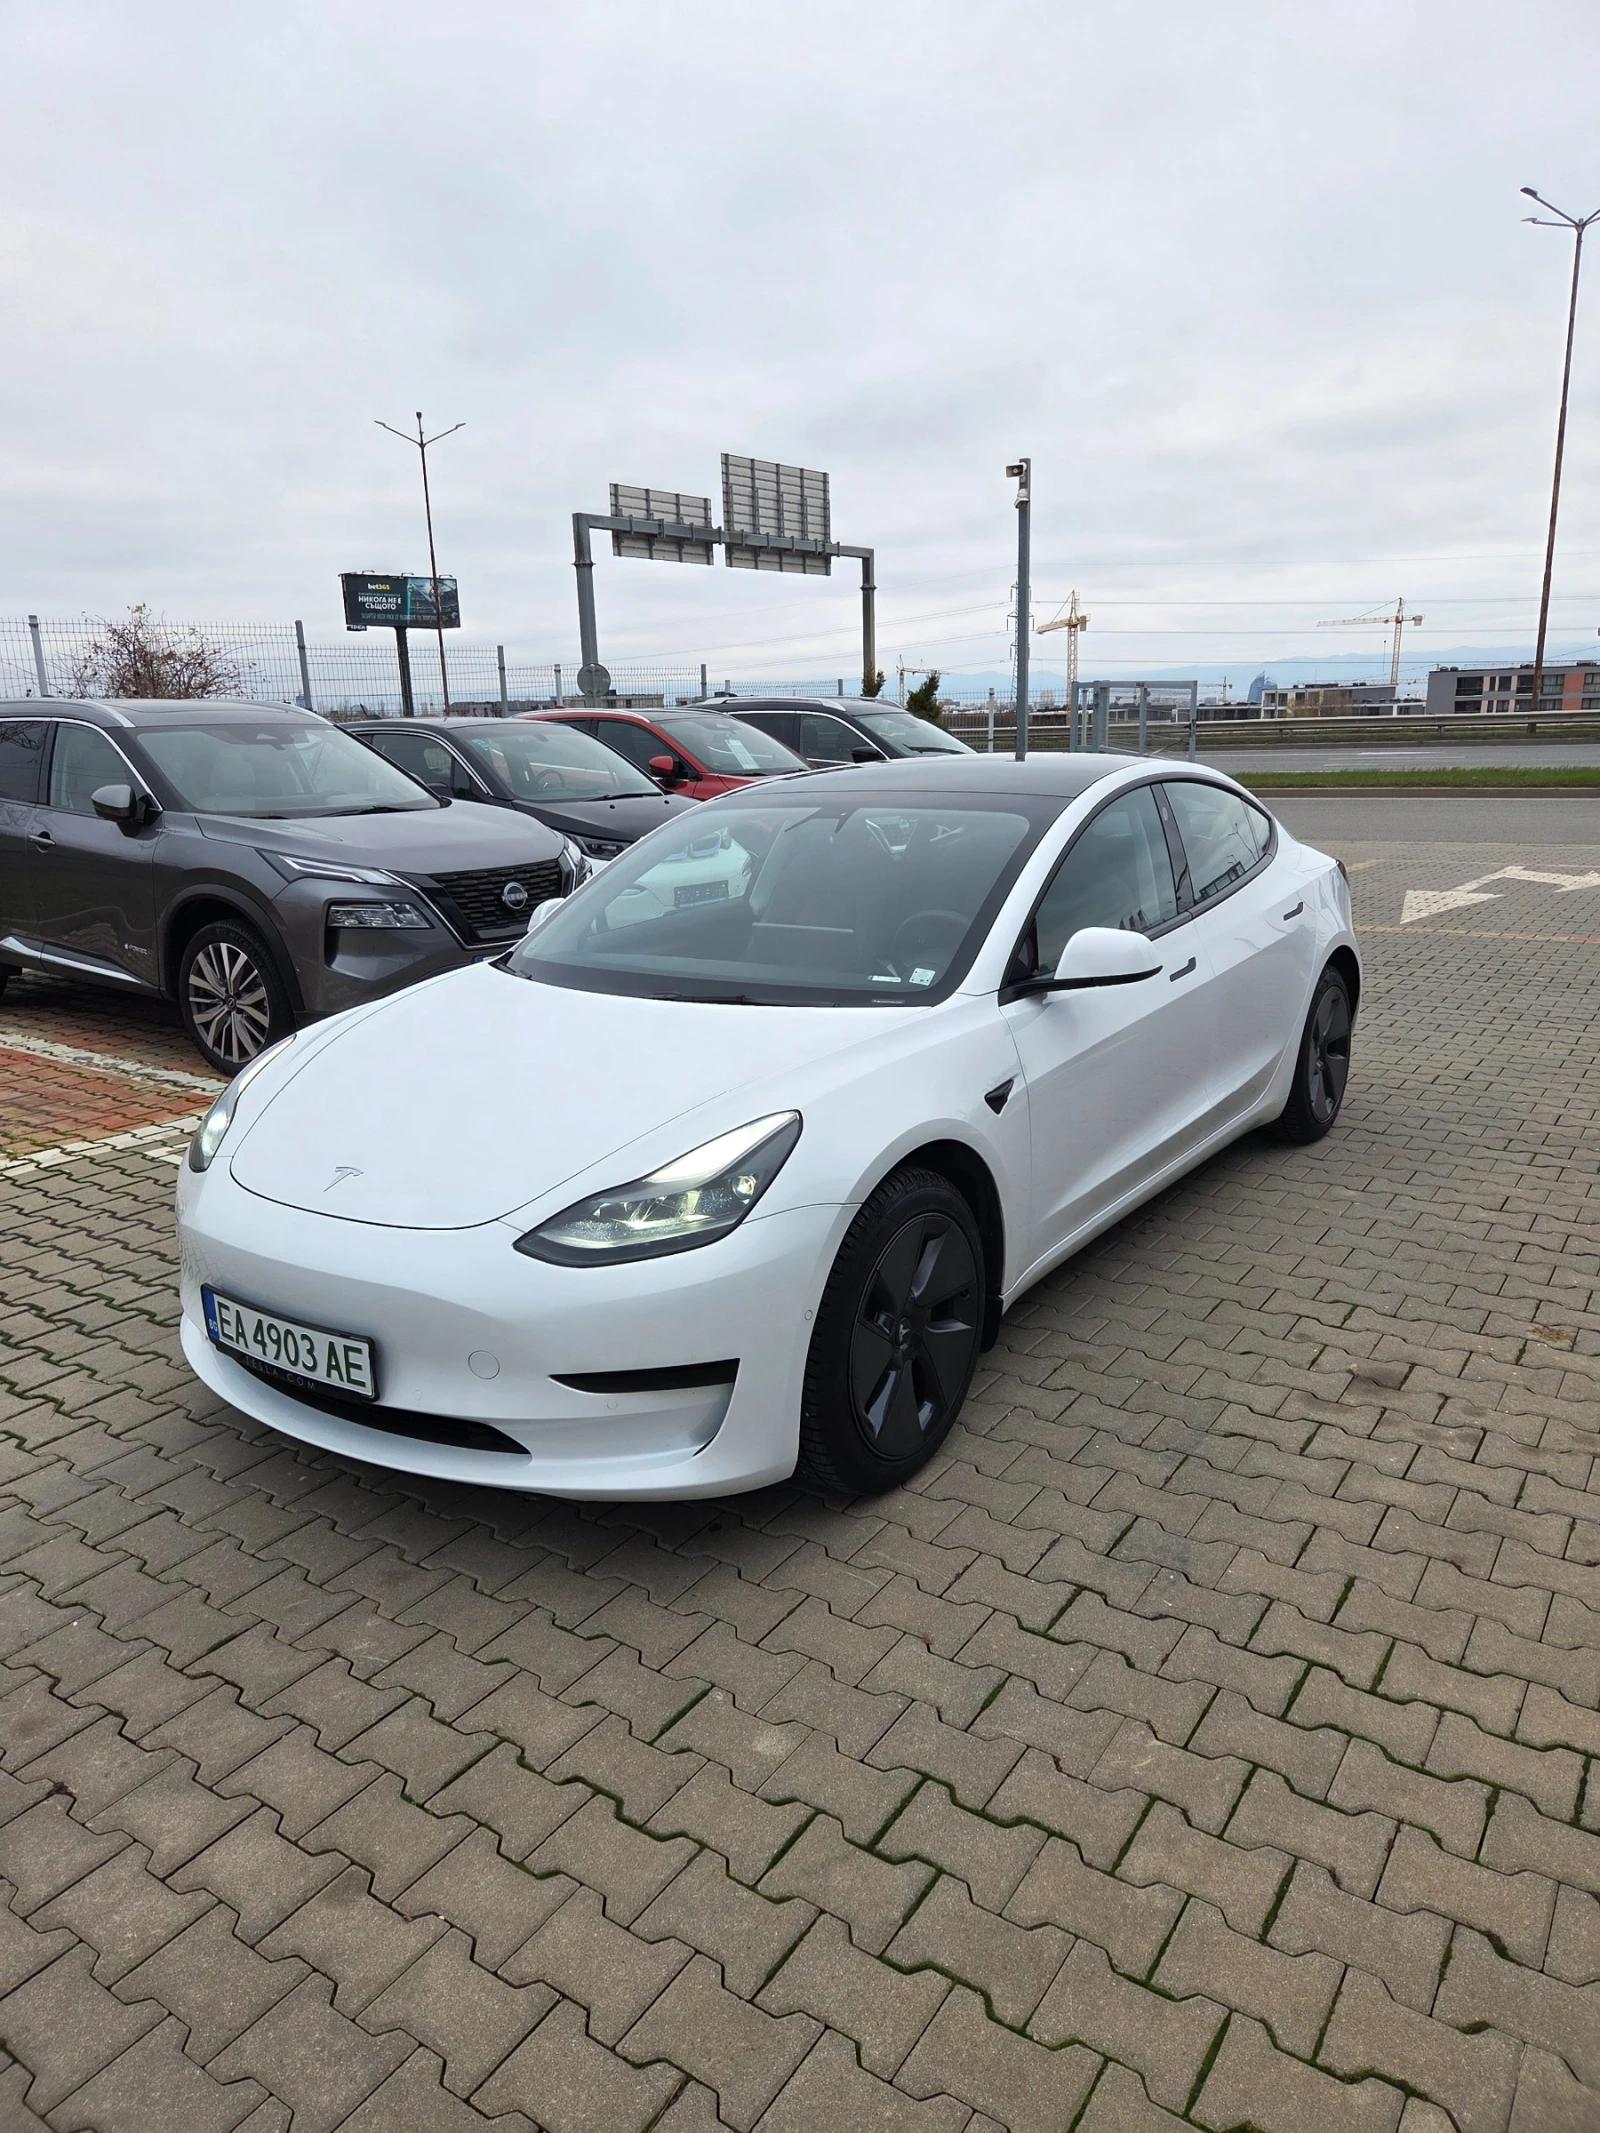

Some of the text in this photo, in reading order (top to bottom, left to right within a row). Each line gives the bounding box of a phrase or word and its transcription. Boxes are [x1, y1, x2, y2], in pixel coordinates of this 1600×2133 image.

[358, 595, 387, 603] НИКОГА
[365, 602, 397, 610] СЪЩОТО
[208, 1319, 218, 1332] BG
[217, 1300, 366, 1388] EA 4903 AE
[245, 1356, 316, 1390] TESLA.COM
